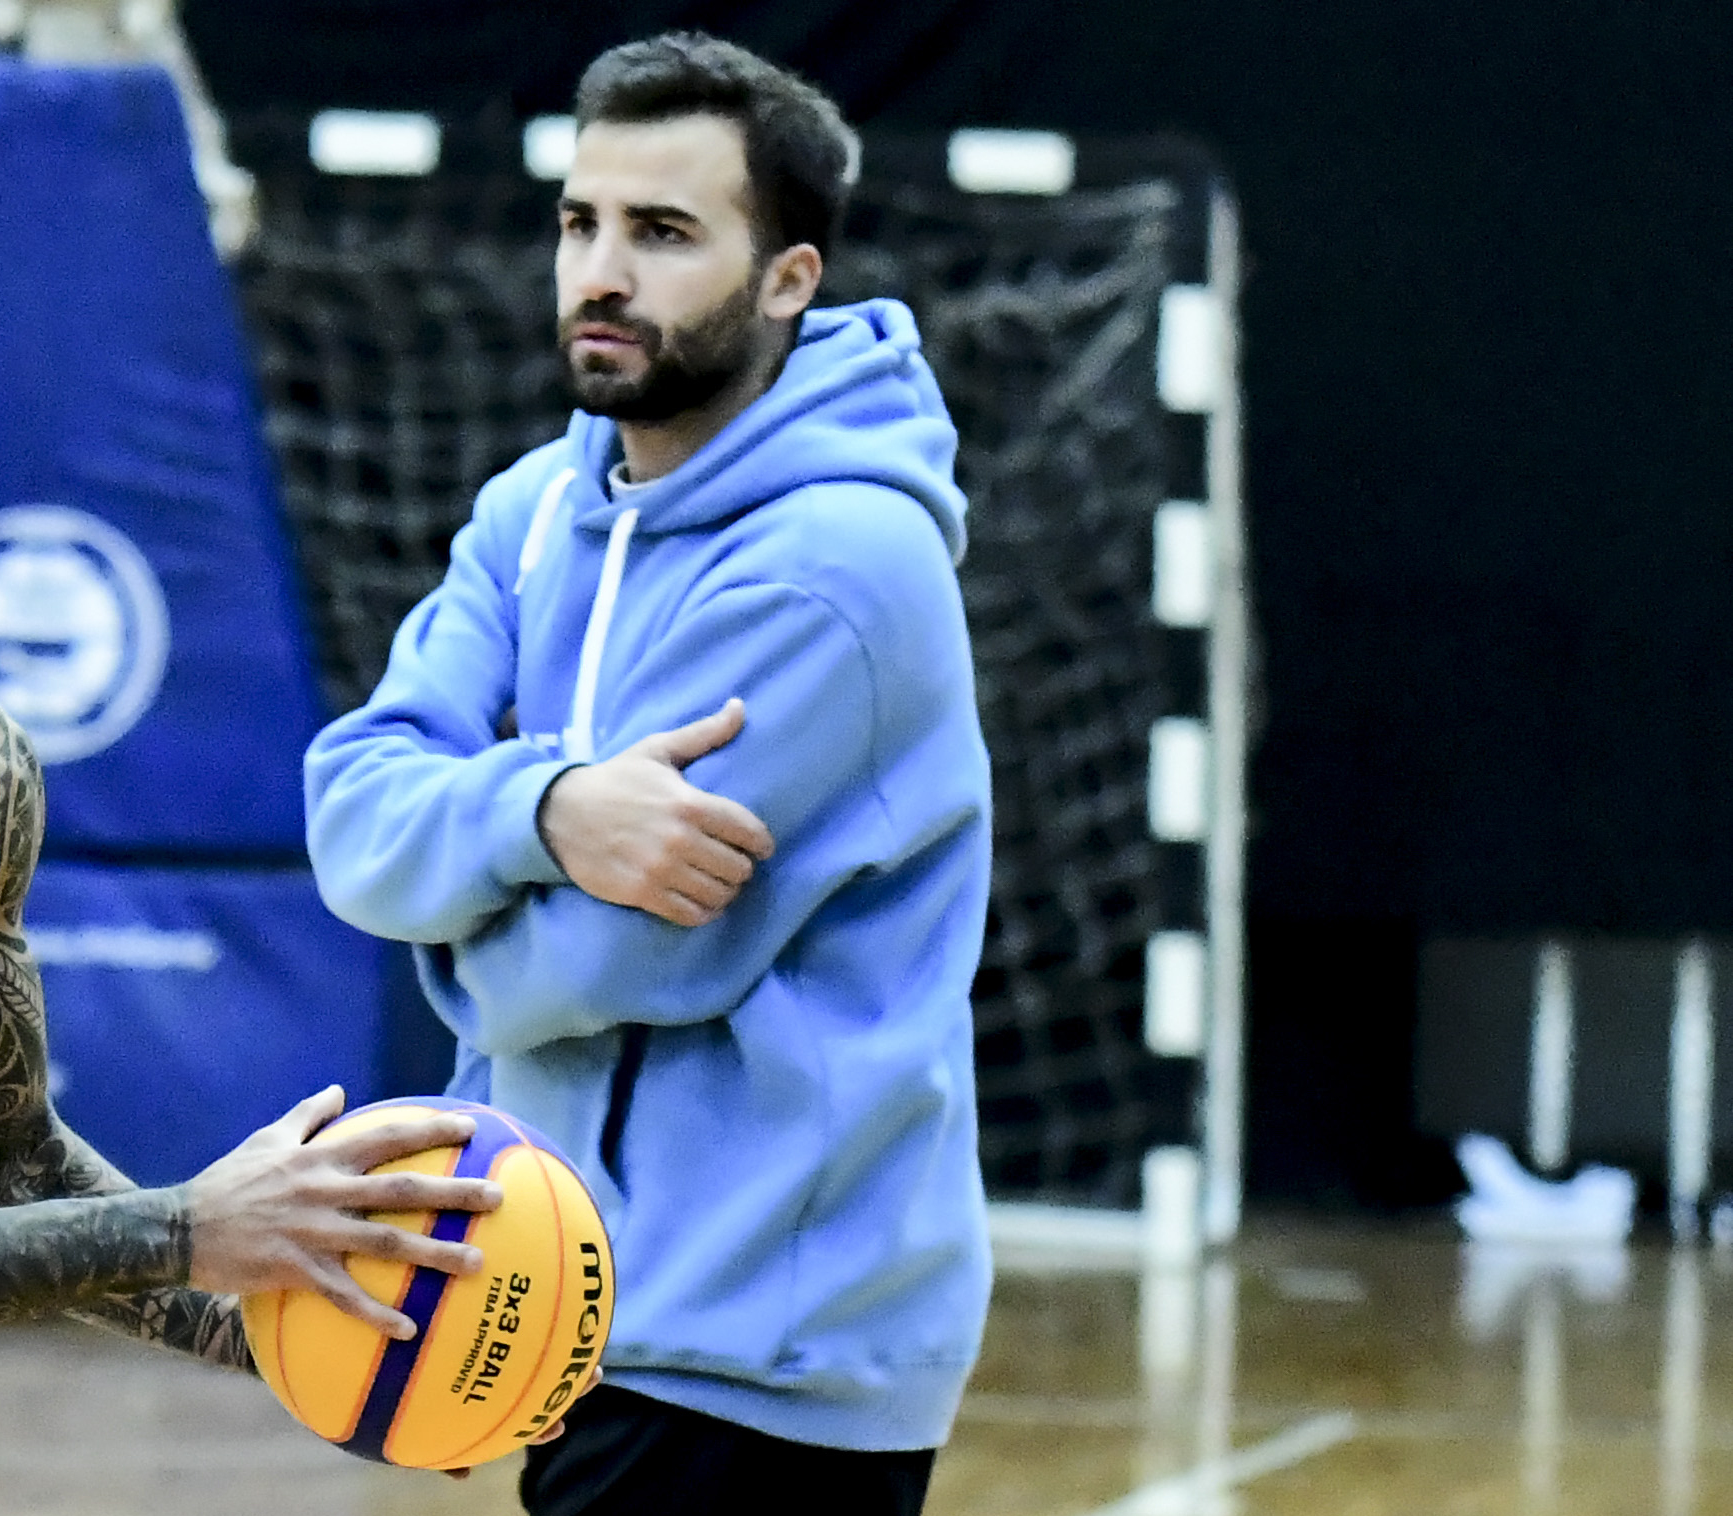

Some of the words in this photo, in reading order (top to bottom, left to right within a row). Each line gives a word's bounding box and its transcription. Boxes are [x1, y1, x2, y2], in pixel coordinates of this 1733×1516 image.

[483, 1276, 503, 1313] FIBA
[450, 1318, 491, 1393] APPROVED
[462, 1341, 511, 1404] BALL
[513, 1242, 603, 1438] molten
